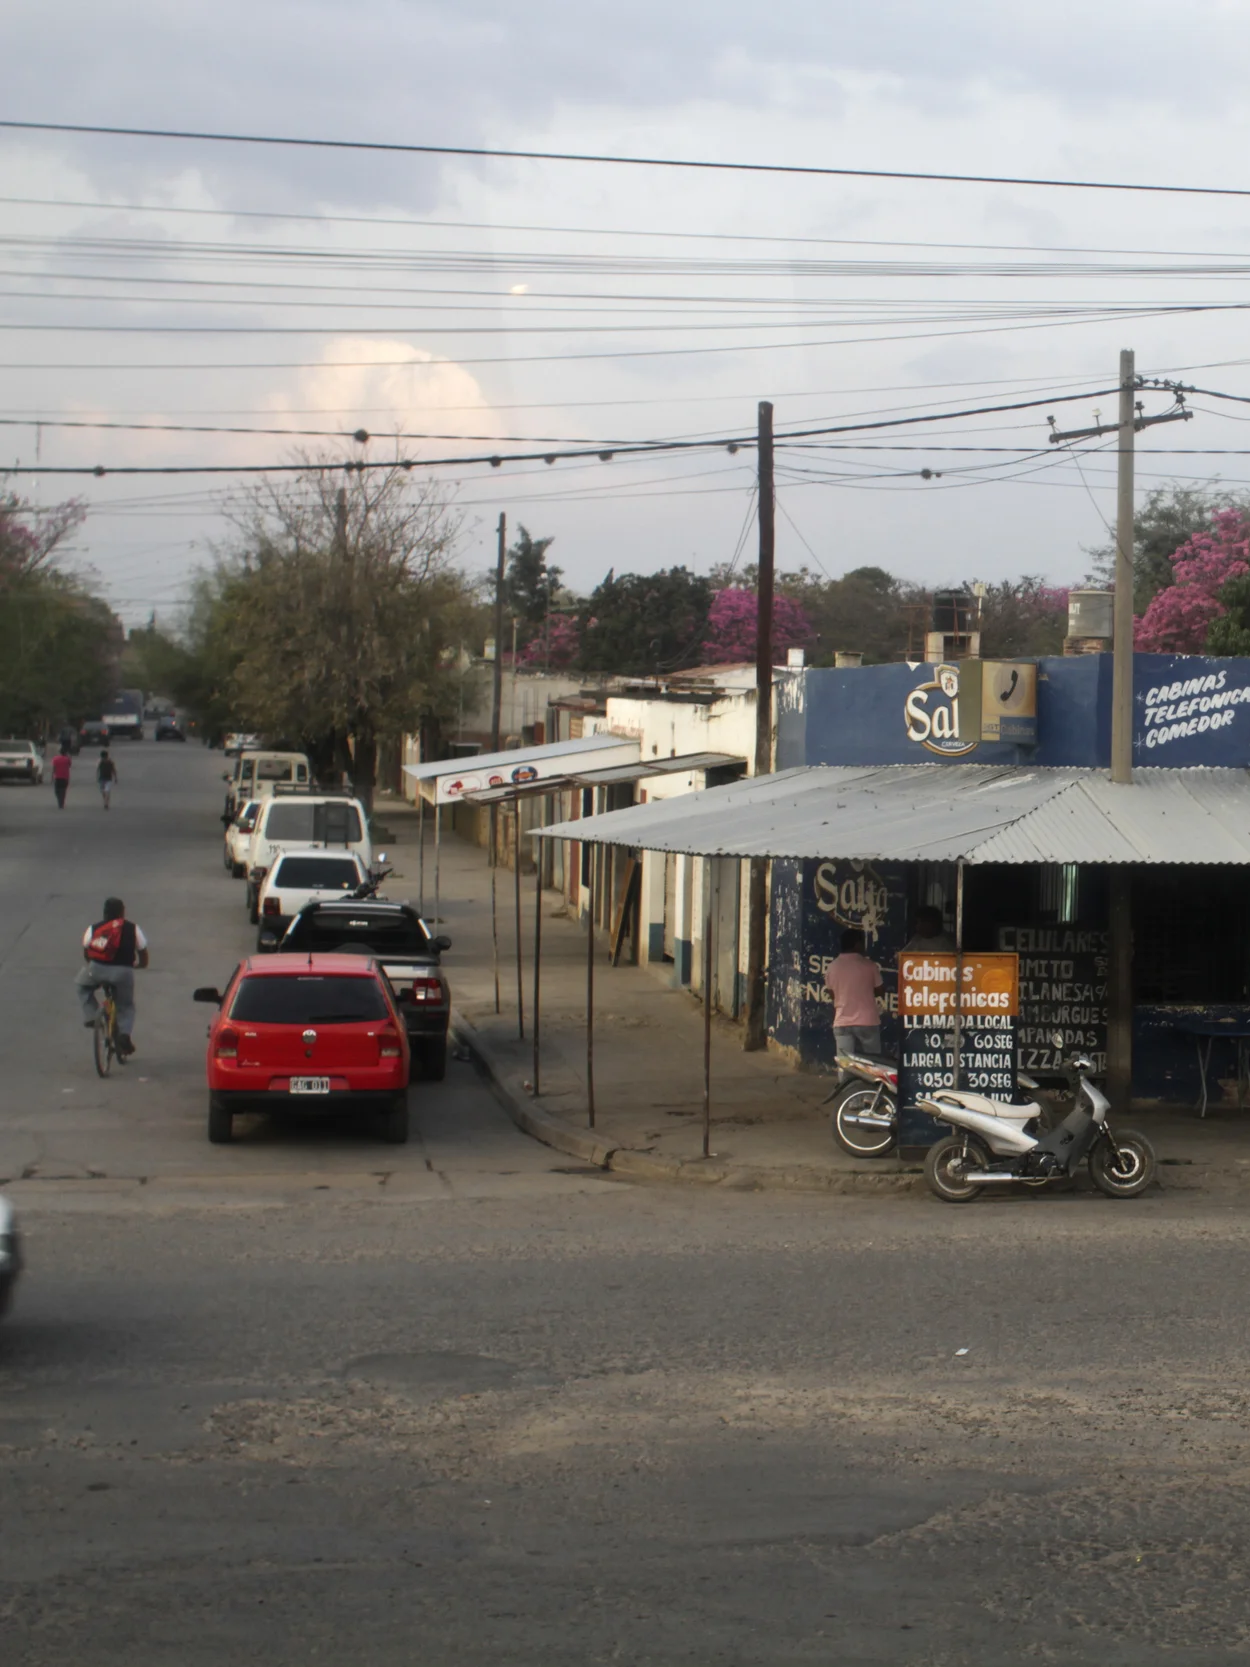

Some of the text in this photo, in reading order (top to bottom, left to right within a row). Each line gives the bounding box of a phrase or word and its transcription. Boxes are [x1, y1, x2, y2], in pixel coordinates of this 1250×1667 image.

[1145, 670, 1228, 706] CABINAS
[906, 690, 959, 742] Sal
[1145, 709, 1236, 749] COMEDOR
[816, 862, 889, 913] Salta
[1019, 981, 1094, 1002] ILANESA
[978, 1014, 1014, 1029] LOCAL
[1017, 1027, 1098, 1047] MPANDAS
[903, 1052, 1012, 1069] LARGA DSTANCIA
